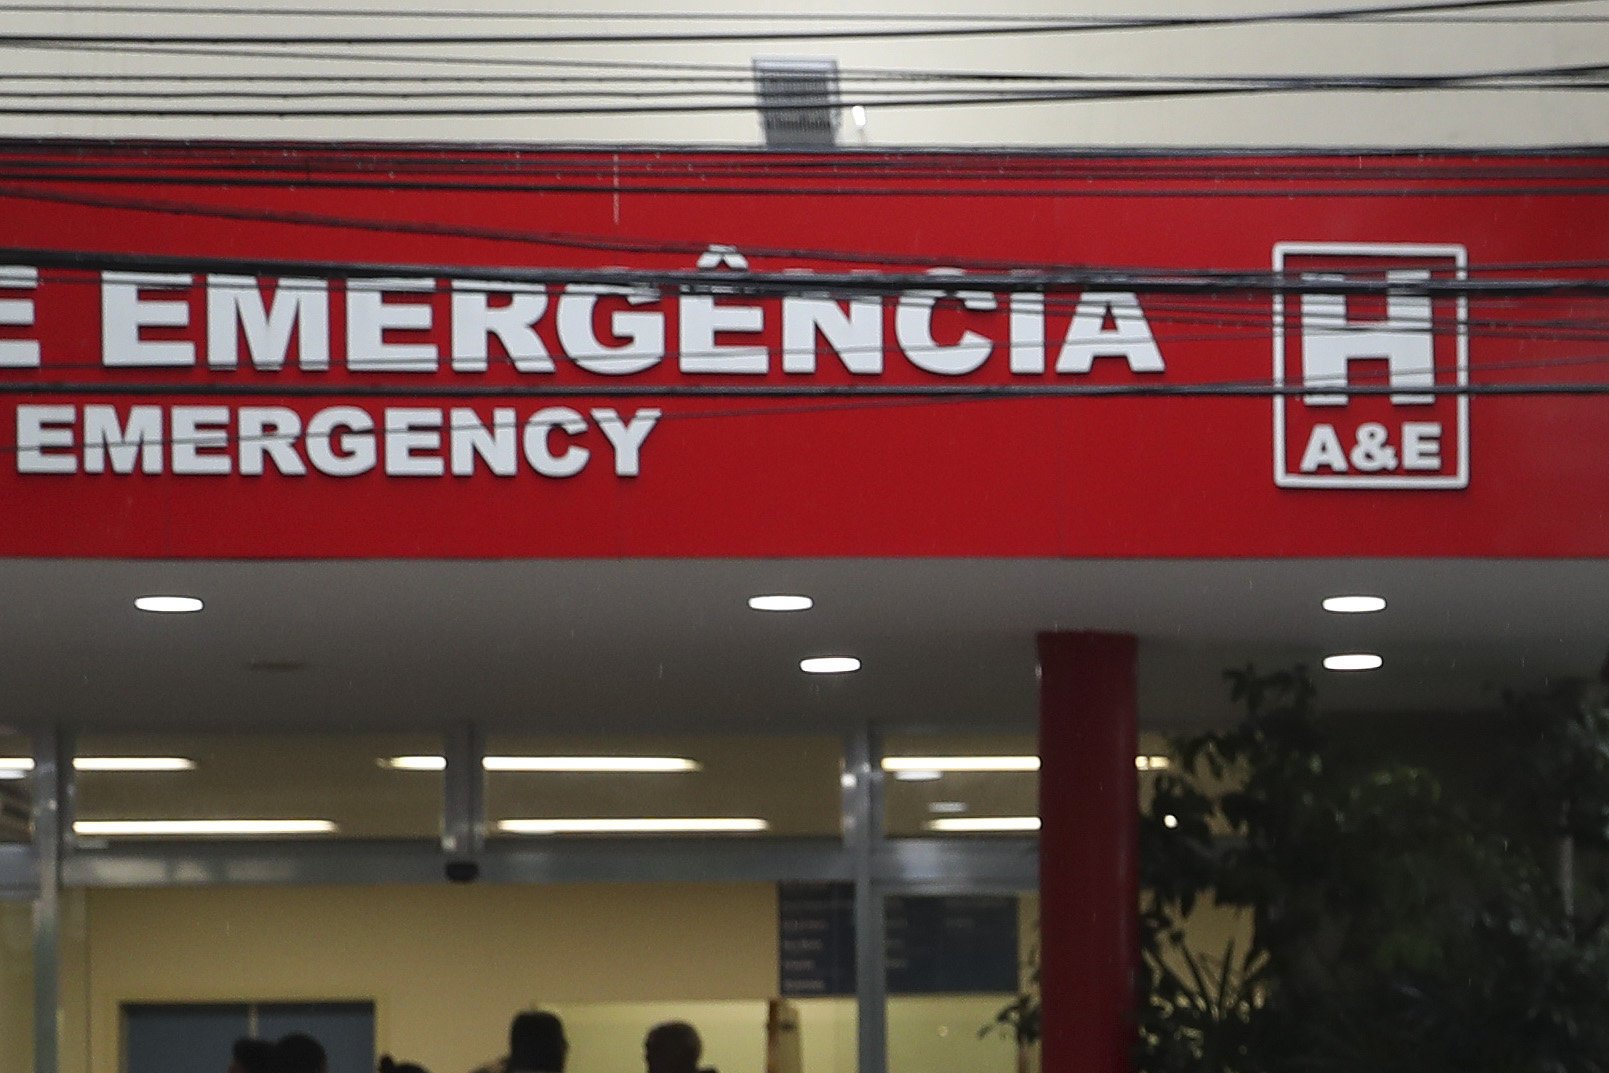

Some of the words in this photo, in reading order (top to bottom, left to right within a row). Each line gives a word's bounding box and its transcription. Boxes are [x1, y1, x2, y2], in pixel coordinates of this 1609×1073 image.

[102, 245, 1166, 376] EMERGÊNCIA
[1302, 269, 1435, 405] H
[15, 405, 664, 477] EMERGENCY
[1301, 422, 1443, 472] A&E
